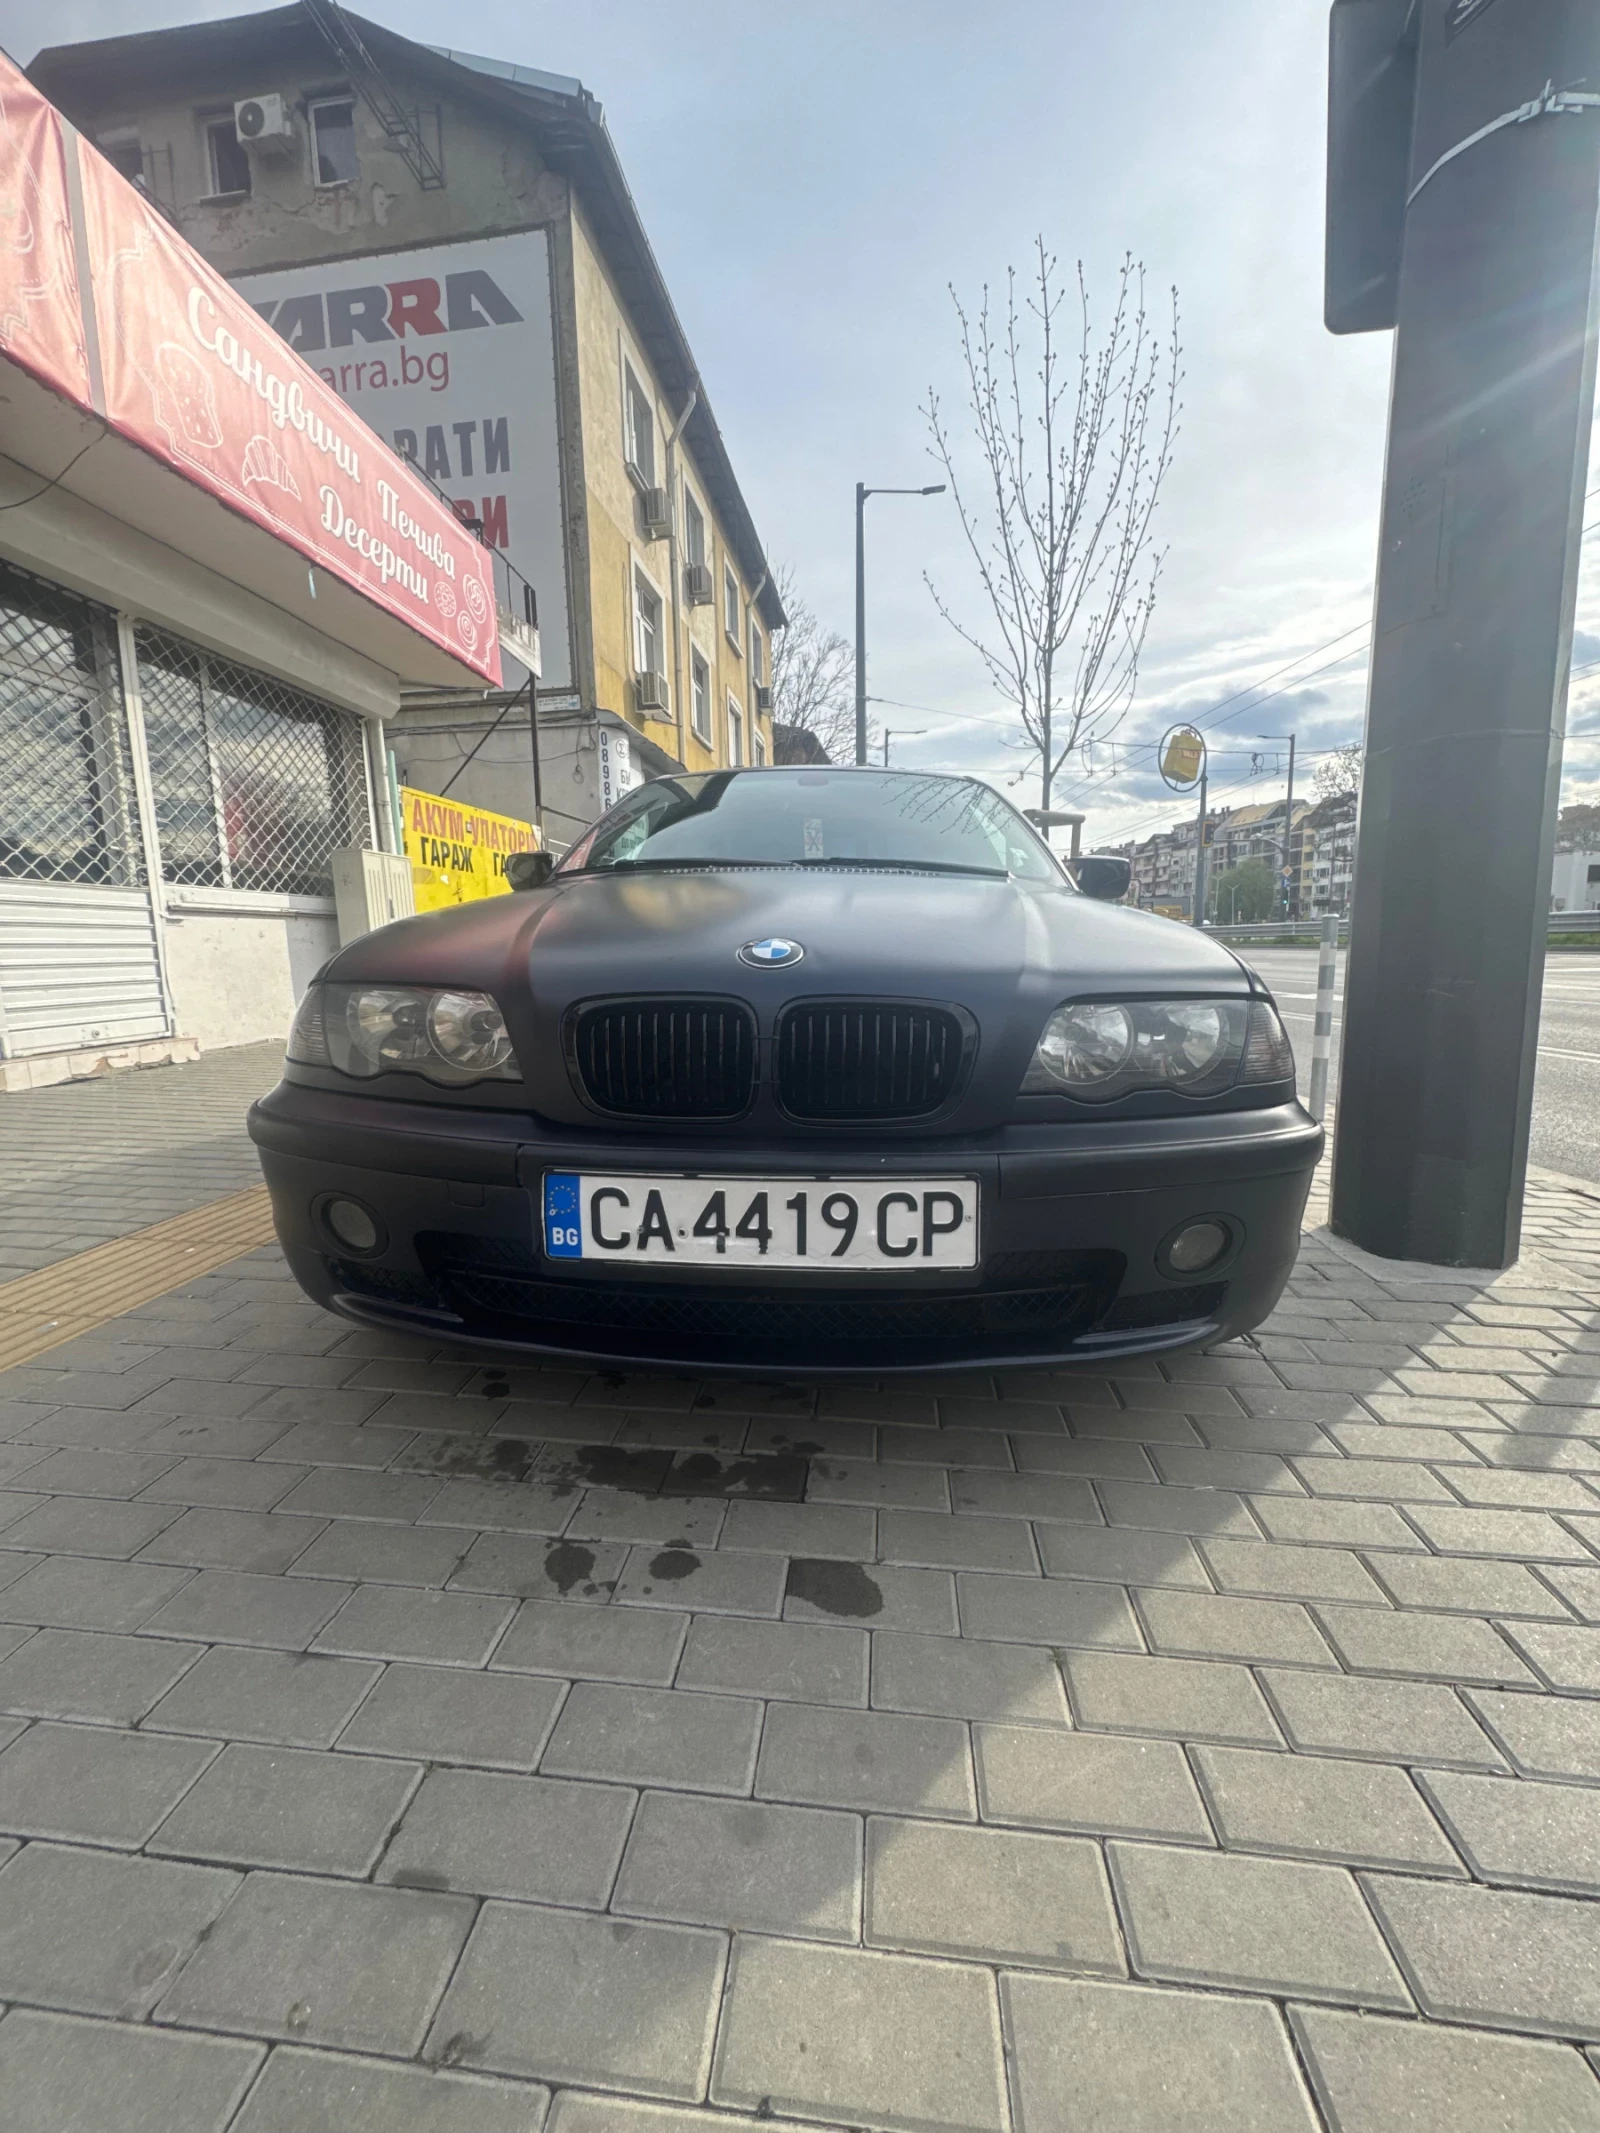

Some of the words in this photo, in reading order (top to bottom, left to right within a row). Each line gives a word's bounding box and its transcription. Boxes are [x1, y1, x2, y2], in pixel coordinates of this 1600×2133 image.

[252, 269, 525, 352] ARRA
[315, 344, 450, 393] arra.bg
[187, 286, 361, 483] Сандвичи
[377, 479, 456, 580] Печива
[377, 417, 511, 481] РАТИ
[319, 485, 429, 604] Десерти
[420, 836, 474, 873] ГАРАЖ
[552, 1226, 579, 1246] BG
[590, 1187, 676, 1251] CA
[692, 1190, 860, 1256] 4419
[876, 1191, 965, 1258] CP
